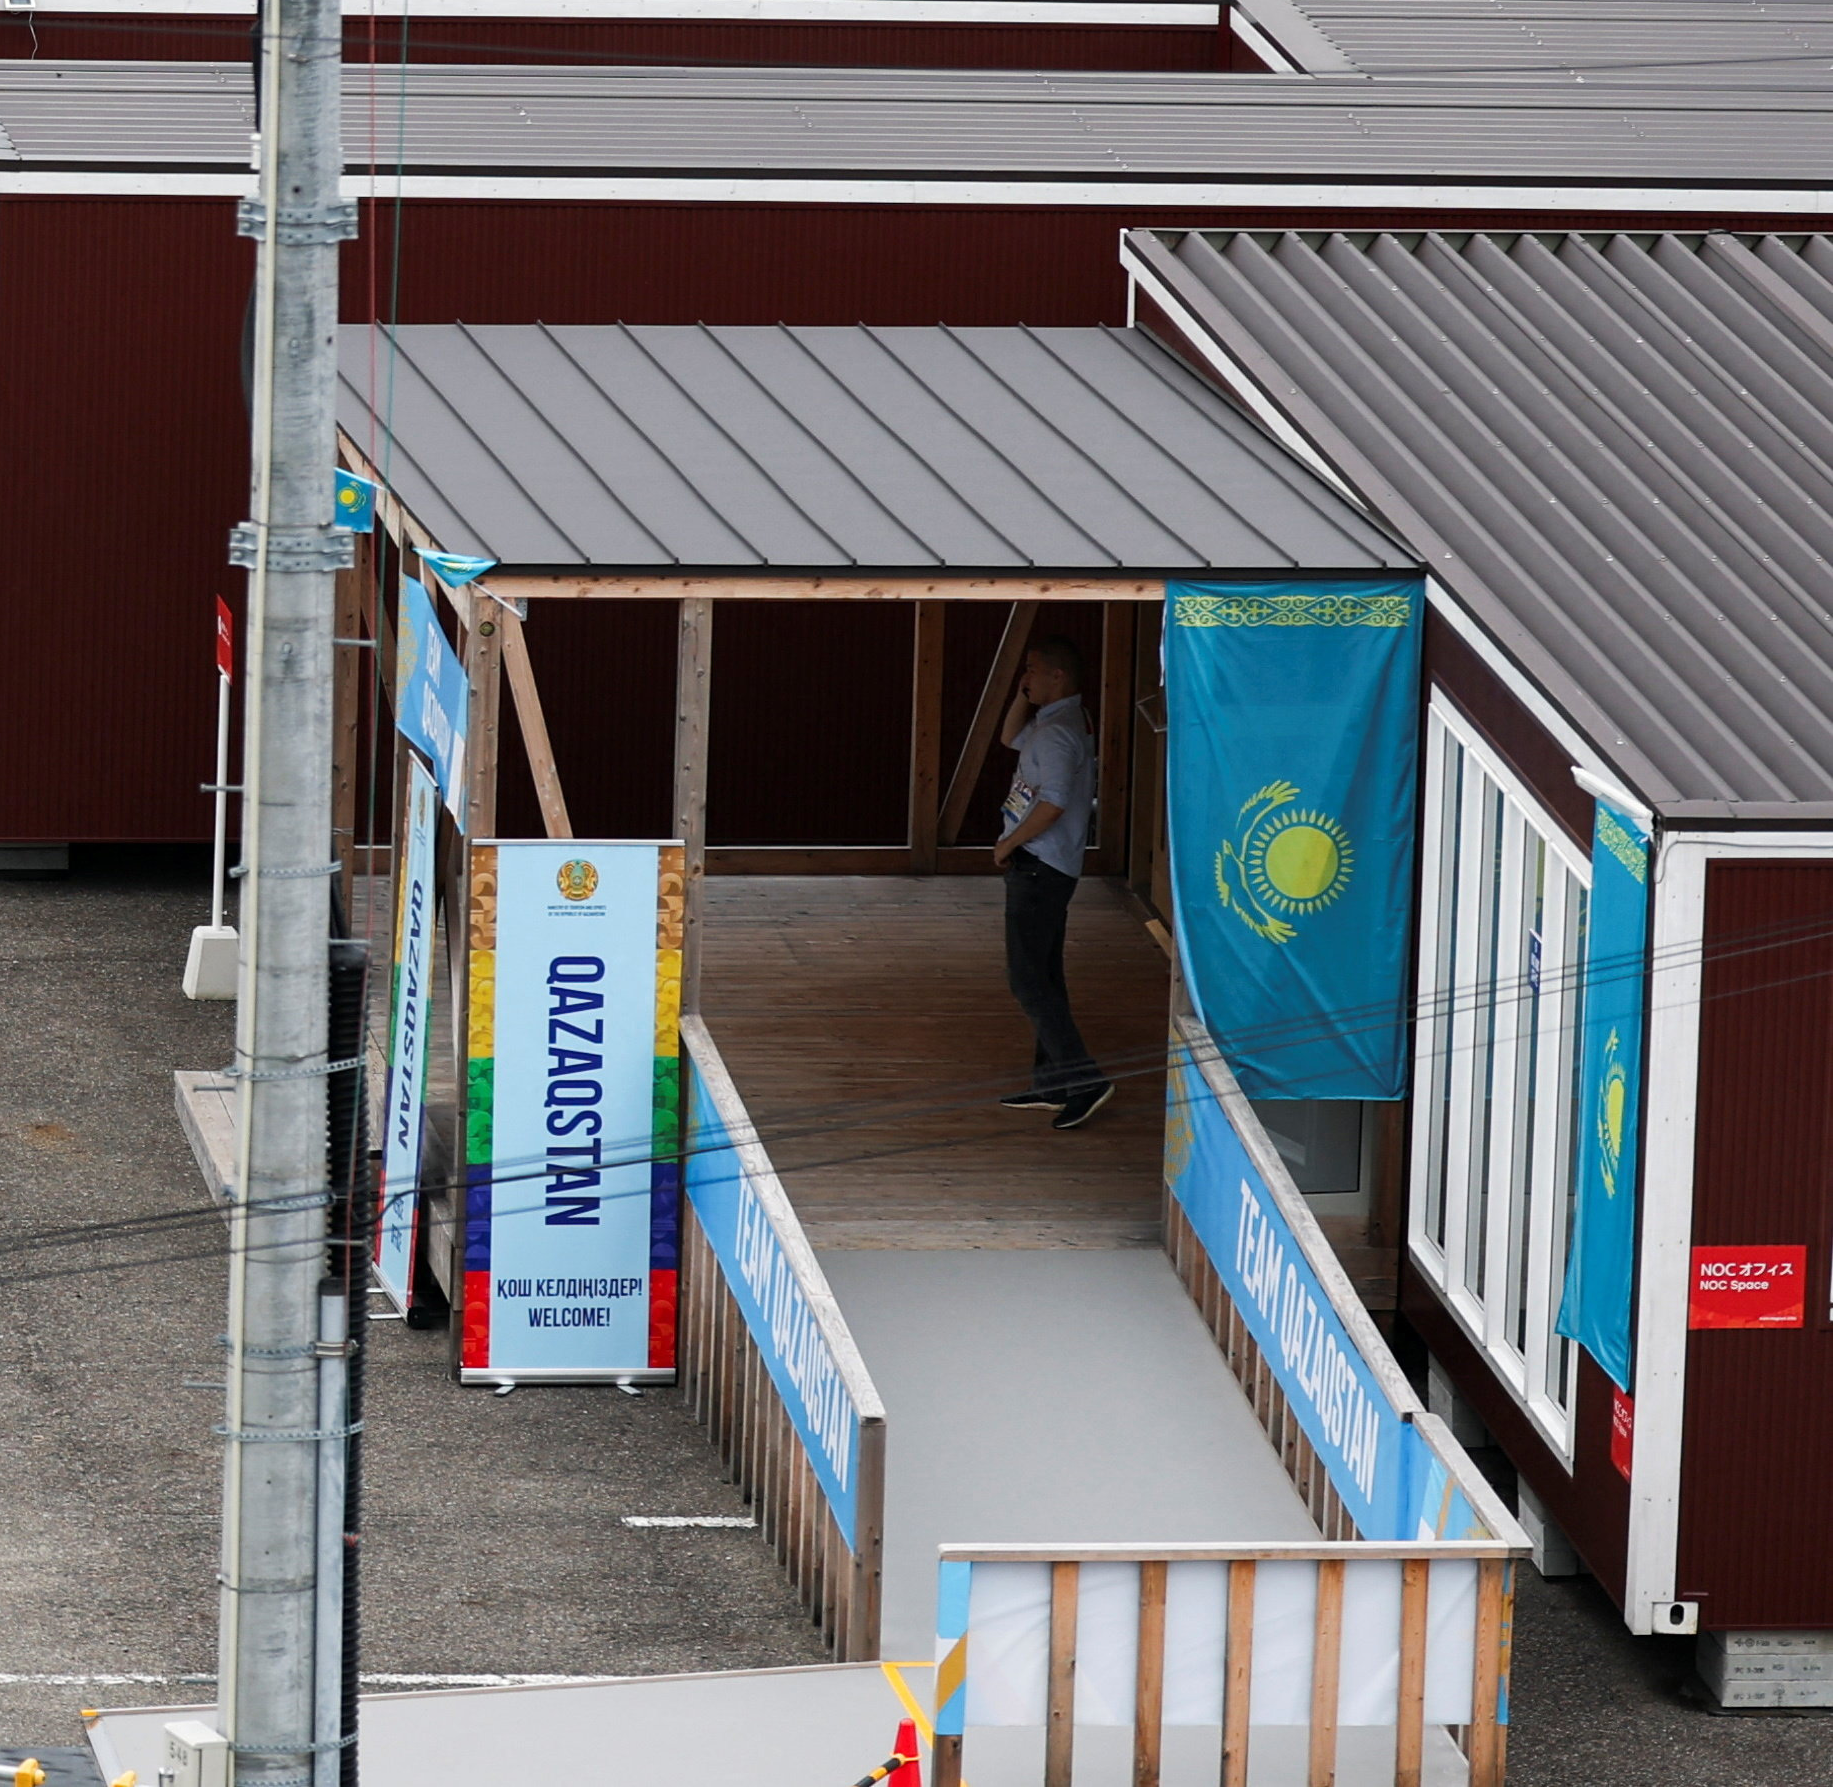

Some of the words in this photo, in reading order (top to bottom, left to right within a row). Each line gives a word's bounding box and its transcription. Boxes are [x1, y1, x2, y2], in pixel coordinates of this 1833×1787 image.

[397, 879, 423, 1151] QAZAQSTAN
[544, 956, 605, 1226] QAZAQSTAN
[497, 1279, 532, 1299] ҚОШ
[536, 1278, 643, 1299] КЕЛДІҢІЗДЕР!
[528, 1307, 611, 1327] WELCOME!
[735, 1164, 776, 1323] TEAM
[771, 1249, 853, 1494] QAZAQSTAN
[1236, 1177, 1284, 1335] TEAM
[1280, 1262, 1380, 1505] QAZAQSTAN
[1700, 1280, 1728, 1290] NOC
[1730, 1280, 1769, 1292] Space
[1701, 1263, 1736, 1277] NOC
[1739, 1262, 1793, 1277] オフィス
